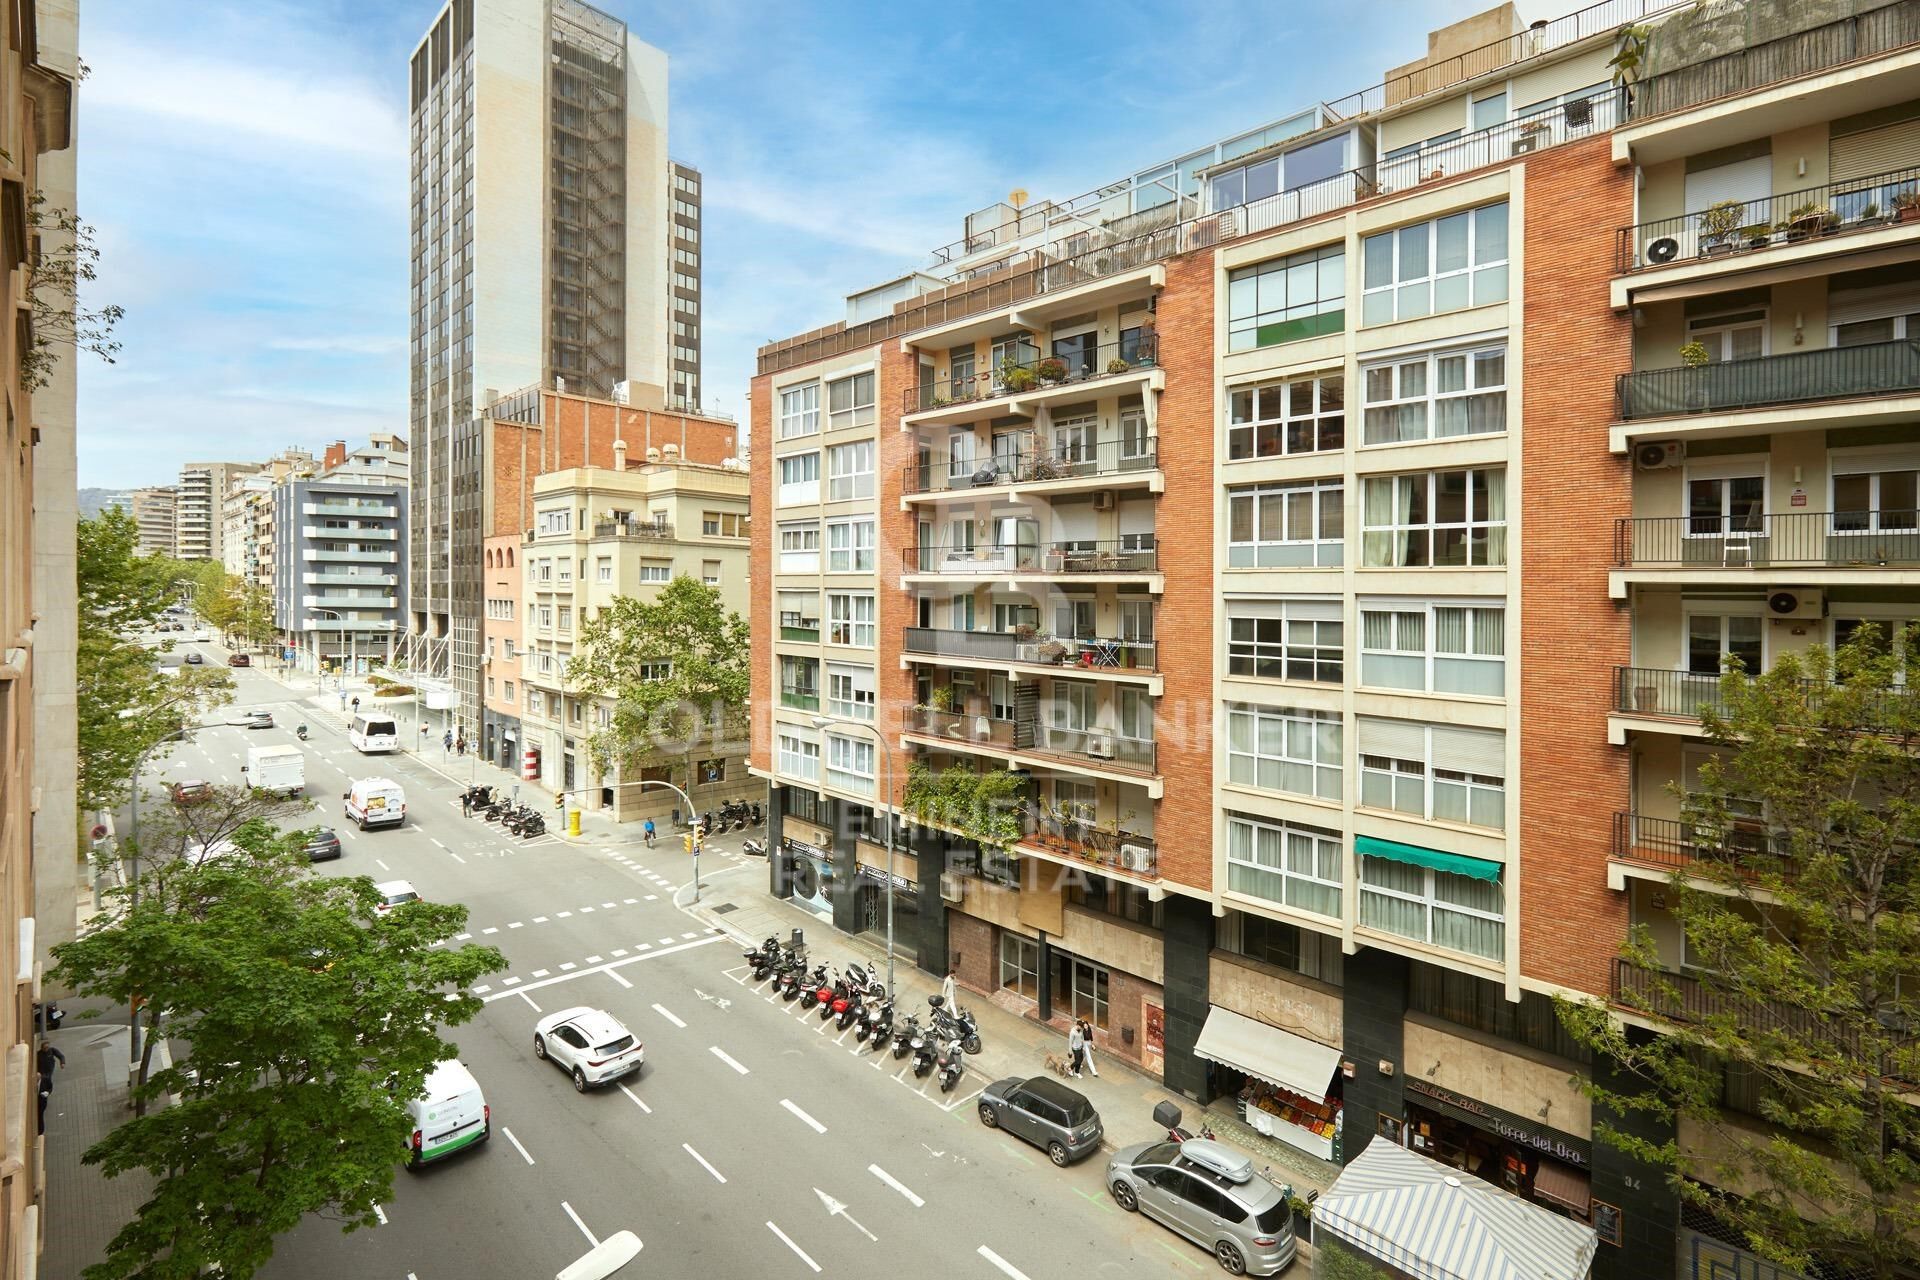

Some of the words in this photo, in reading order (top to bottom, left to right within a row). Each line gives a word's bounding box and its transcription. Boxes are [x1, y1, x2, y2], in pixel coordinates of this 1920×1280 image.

[1414, 1083, 1452, 1102] SNACK
[1459, 1098, 1484, 1115] BAR
[1493, 1117, 1528, 1143] Torre
[1532, 1135, 1551, 1153] del
[1556, 1143, 1581, 1162] Oro
[1624, 1175, 1641, 1190] 34
